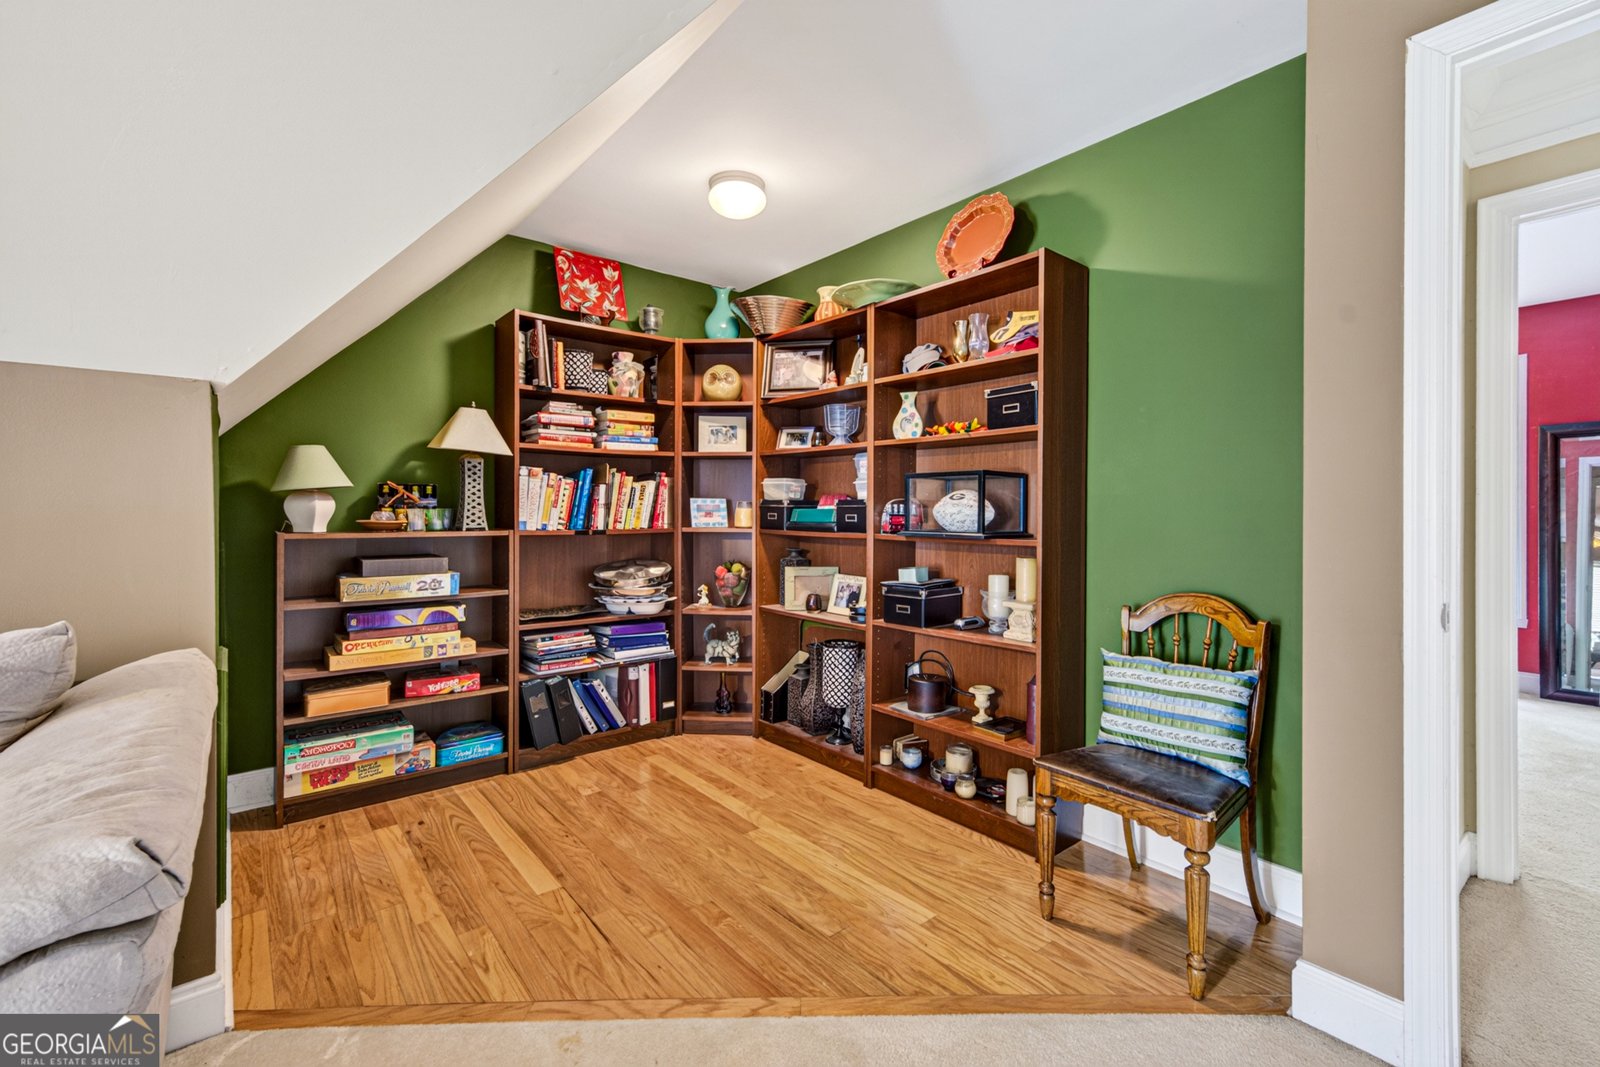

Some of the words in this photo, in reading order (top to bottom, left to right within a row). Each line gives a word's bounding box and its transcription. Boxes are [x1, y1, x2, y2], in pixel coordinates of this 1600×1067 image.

[301, 740, 356, 757] MONOPOLY
[295, 759, 326, 771] CANDY
[327, 754, 351, 766] LAND
